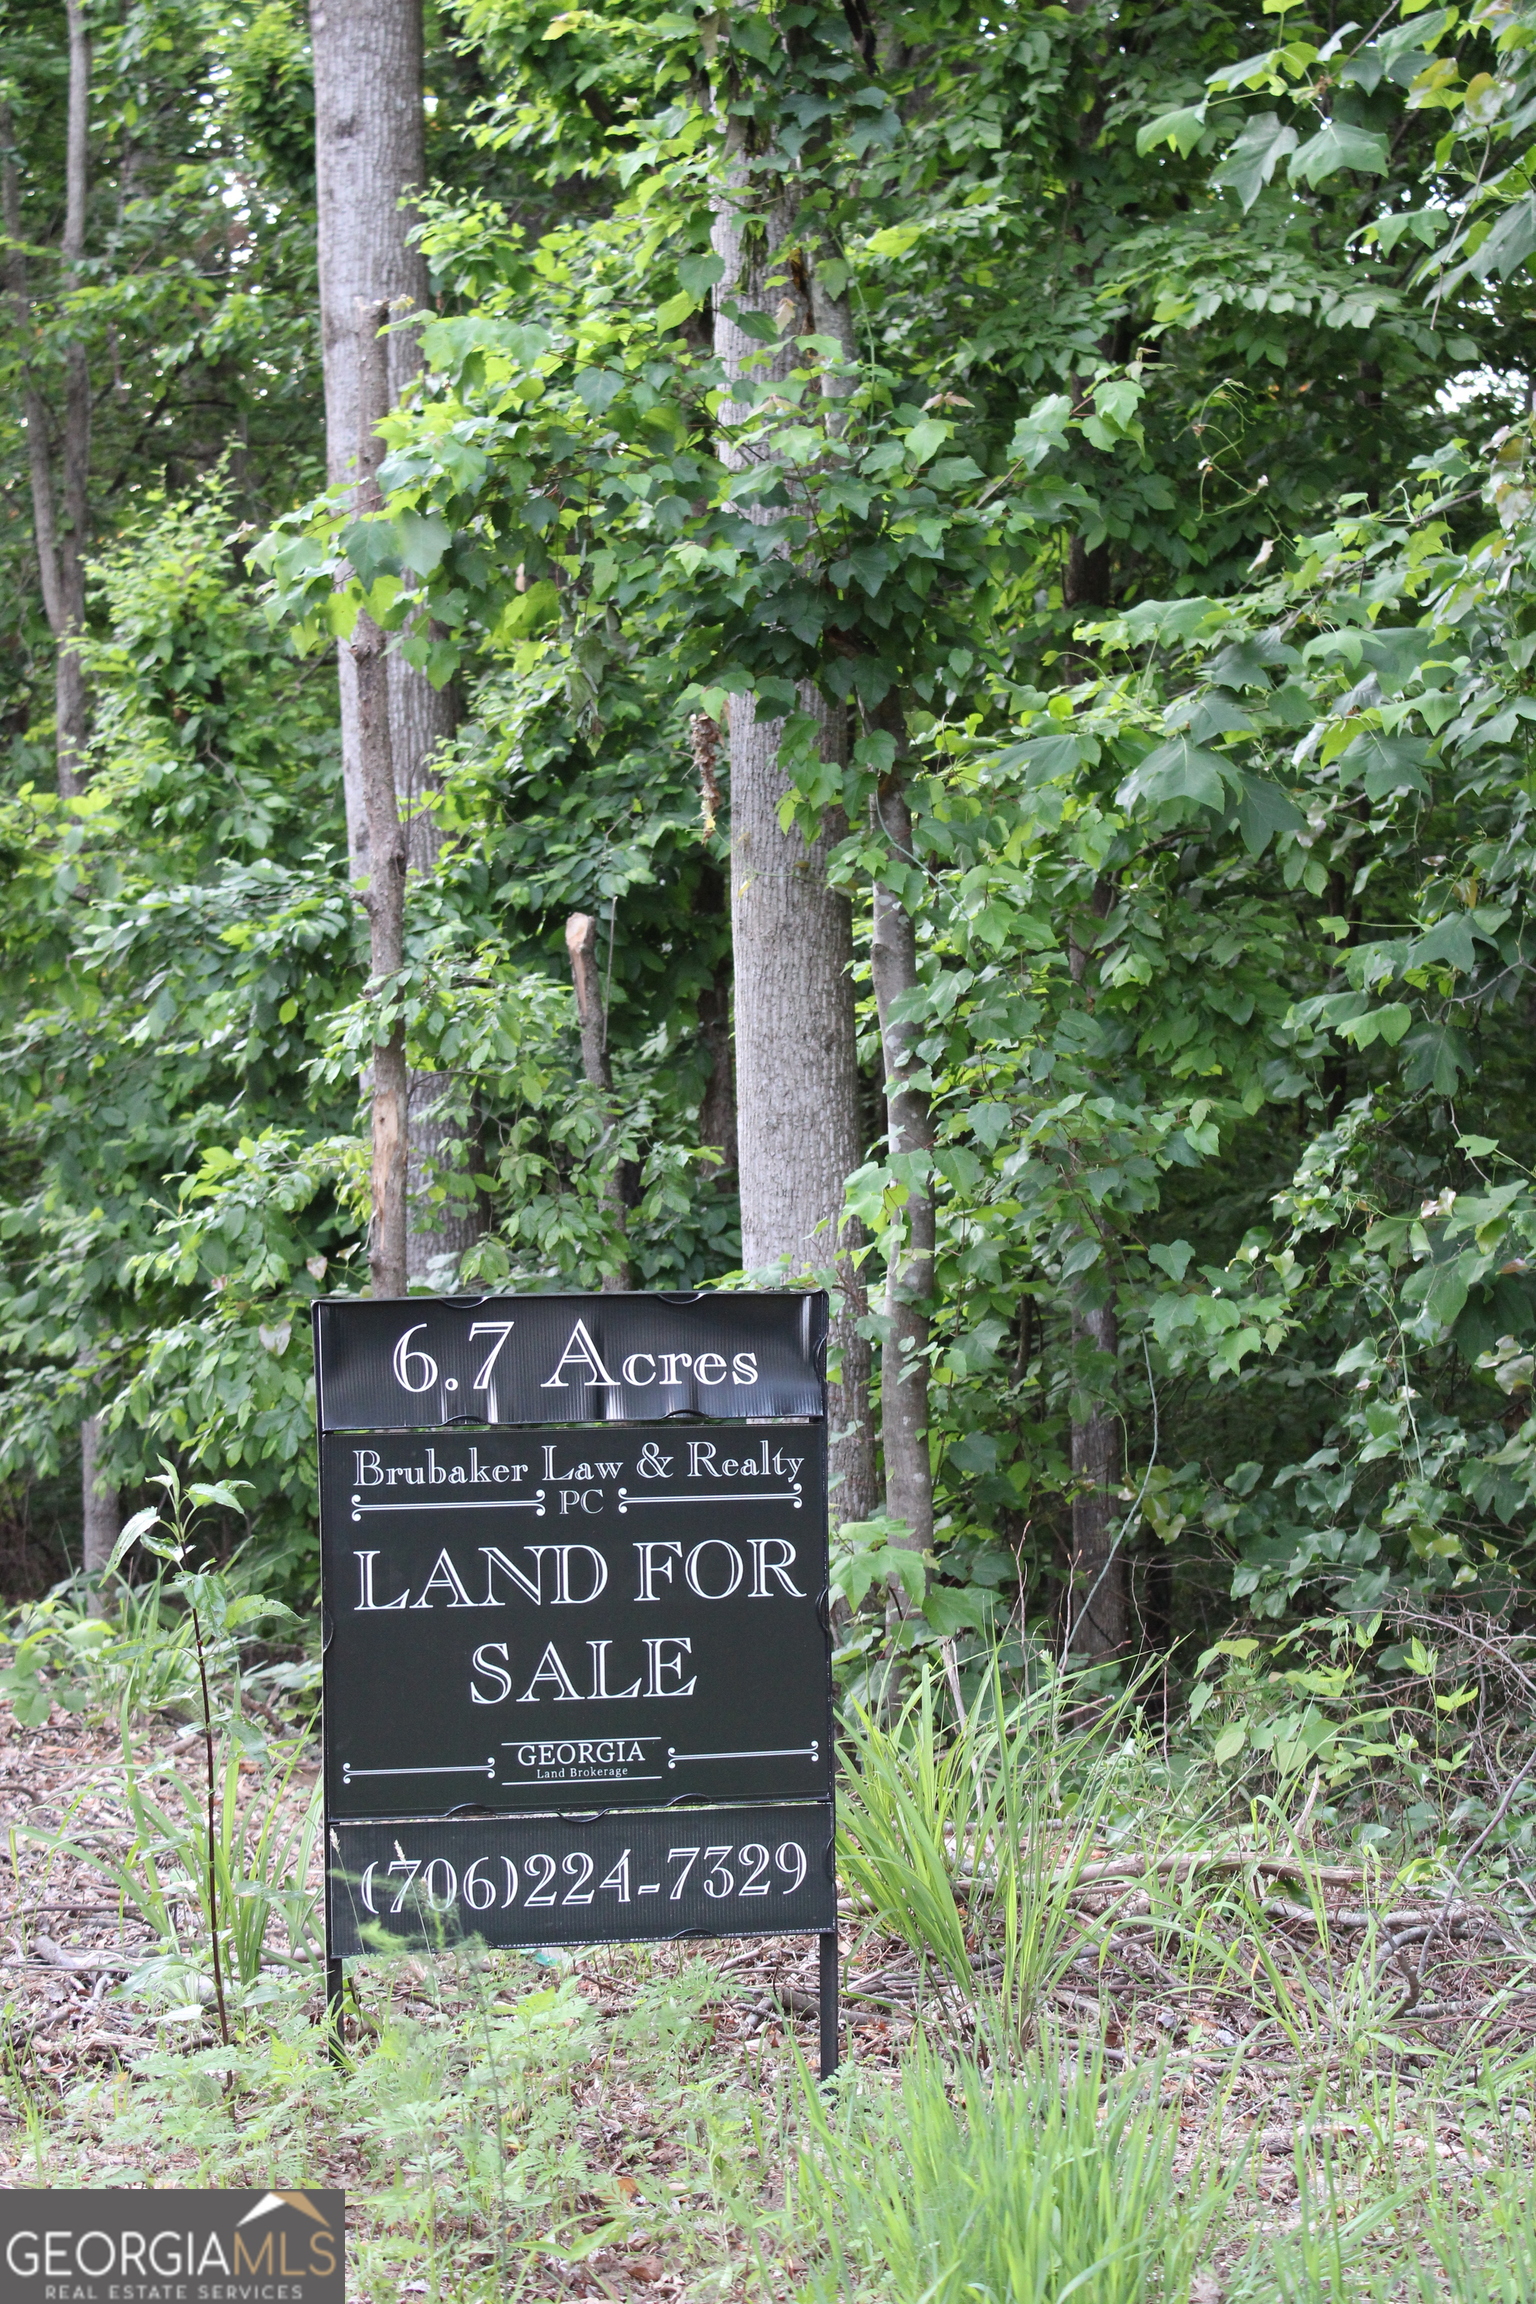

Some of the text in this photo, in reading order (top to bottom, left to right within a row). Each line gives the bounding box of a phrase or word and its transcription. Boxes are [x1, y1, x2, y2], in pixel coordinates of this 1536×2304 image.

[392, 1318, 759, 1393] 6.7 Acres
[352, 1439, 805, 1487] Brubaker Law & Realty
[558, 1488, 605, 1515] PC
[352, 1537, 807, 1611] LAND FOR
[470, 1636, 698, 1705] SALE
[517, 1741, 646, 1767] GEORGIA
[537, 1766, 629, 1779] Land Brokerage
[360, 1840, 808, 1915] (706)224-7329
